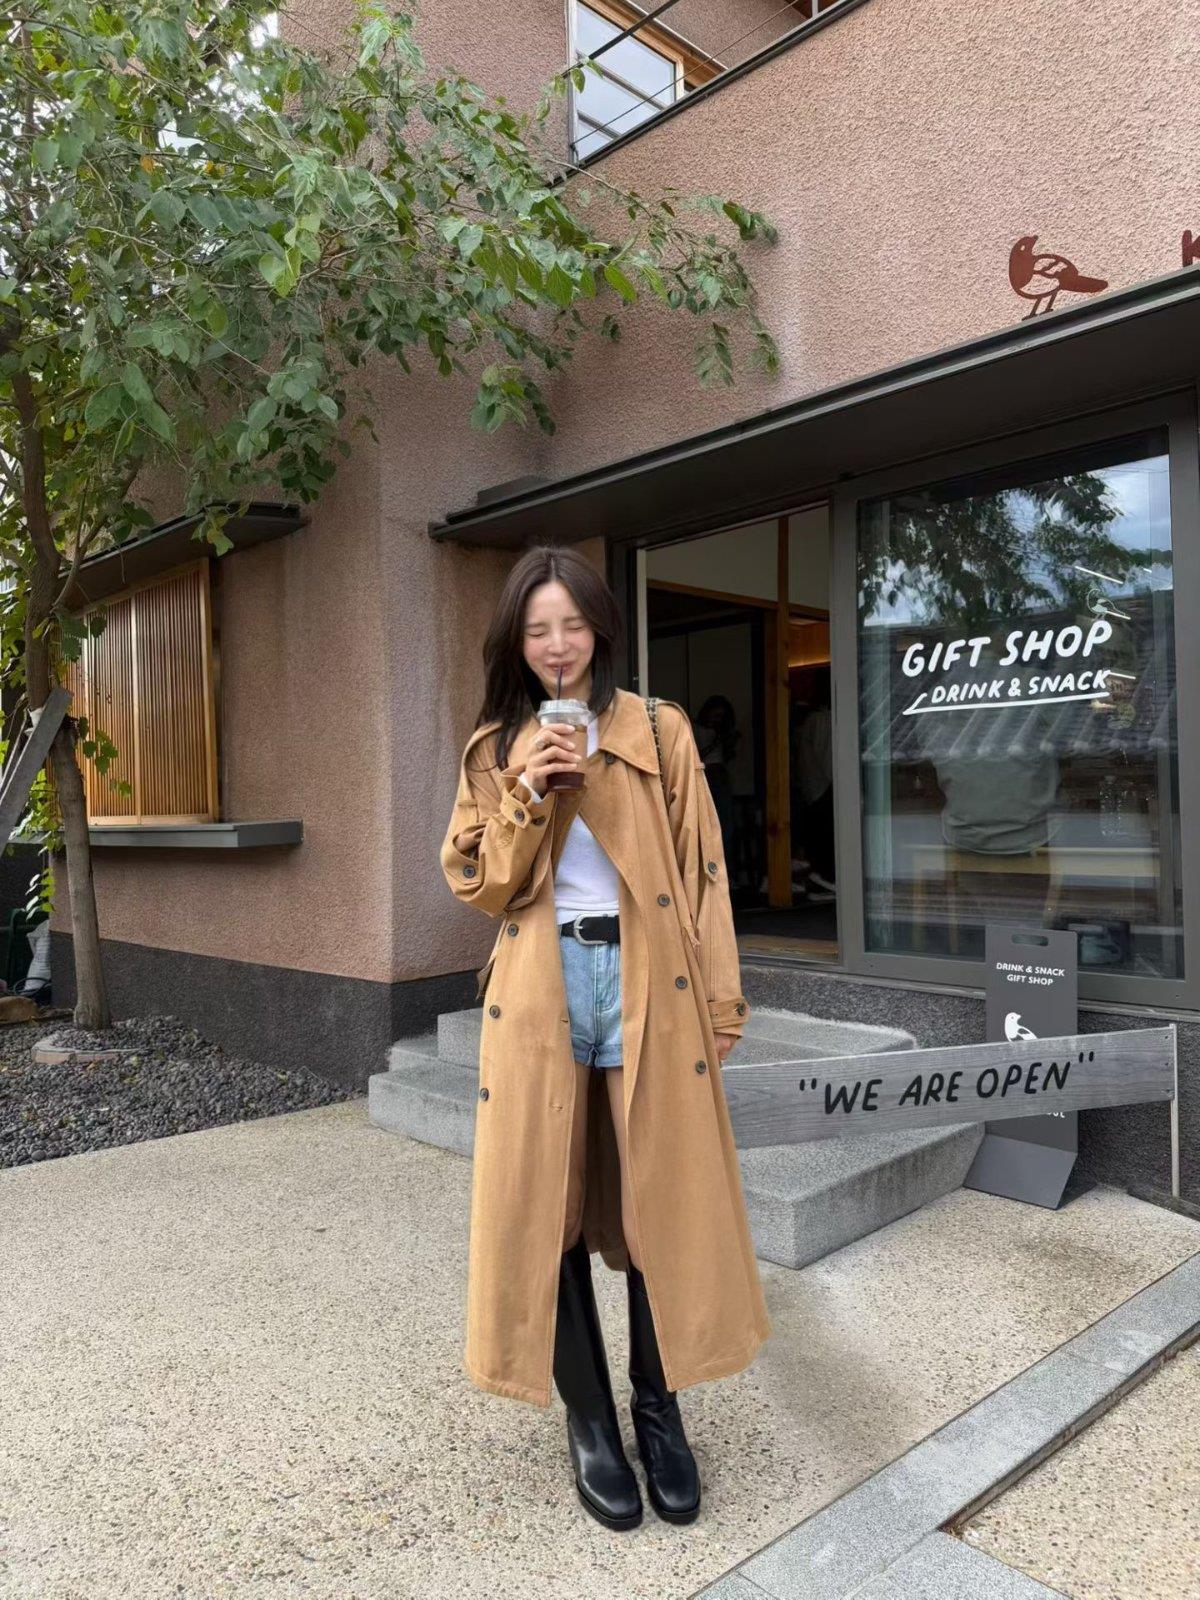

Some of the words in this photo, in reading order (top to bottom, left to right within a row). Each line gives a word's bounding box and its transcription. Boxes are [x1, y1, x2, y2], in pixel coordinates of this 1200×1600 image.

[902, 636, 991, 677] GIFT
[1000, 620, 1113, 666] SHOP
[931, 679, 1004, 703] DRINK
[1007, 677, 1021, 697] &
[1028, 669, 1111, 695] SNACK
[996, 962, 1024, 972] DRINK
[1025, 965, 1033, 974] &
[1034, 966, 1066, 977] SNACK
[1006, 974, 1027, 983] GIFT
[1028, 976, 1054, 986] SHOP
[899, 1071, 963, 1106] ARE
